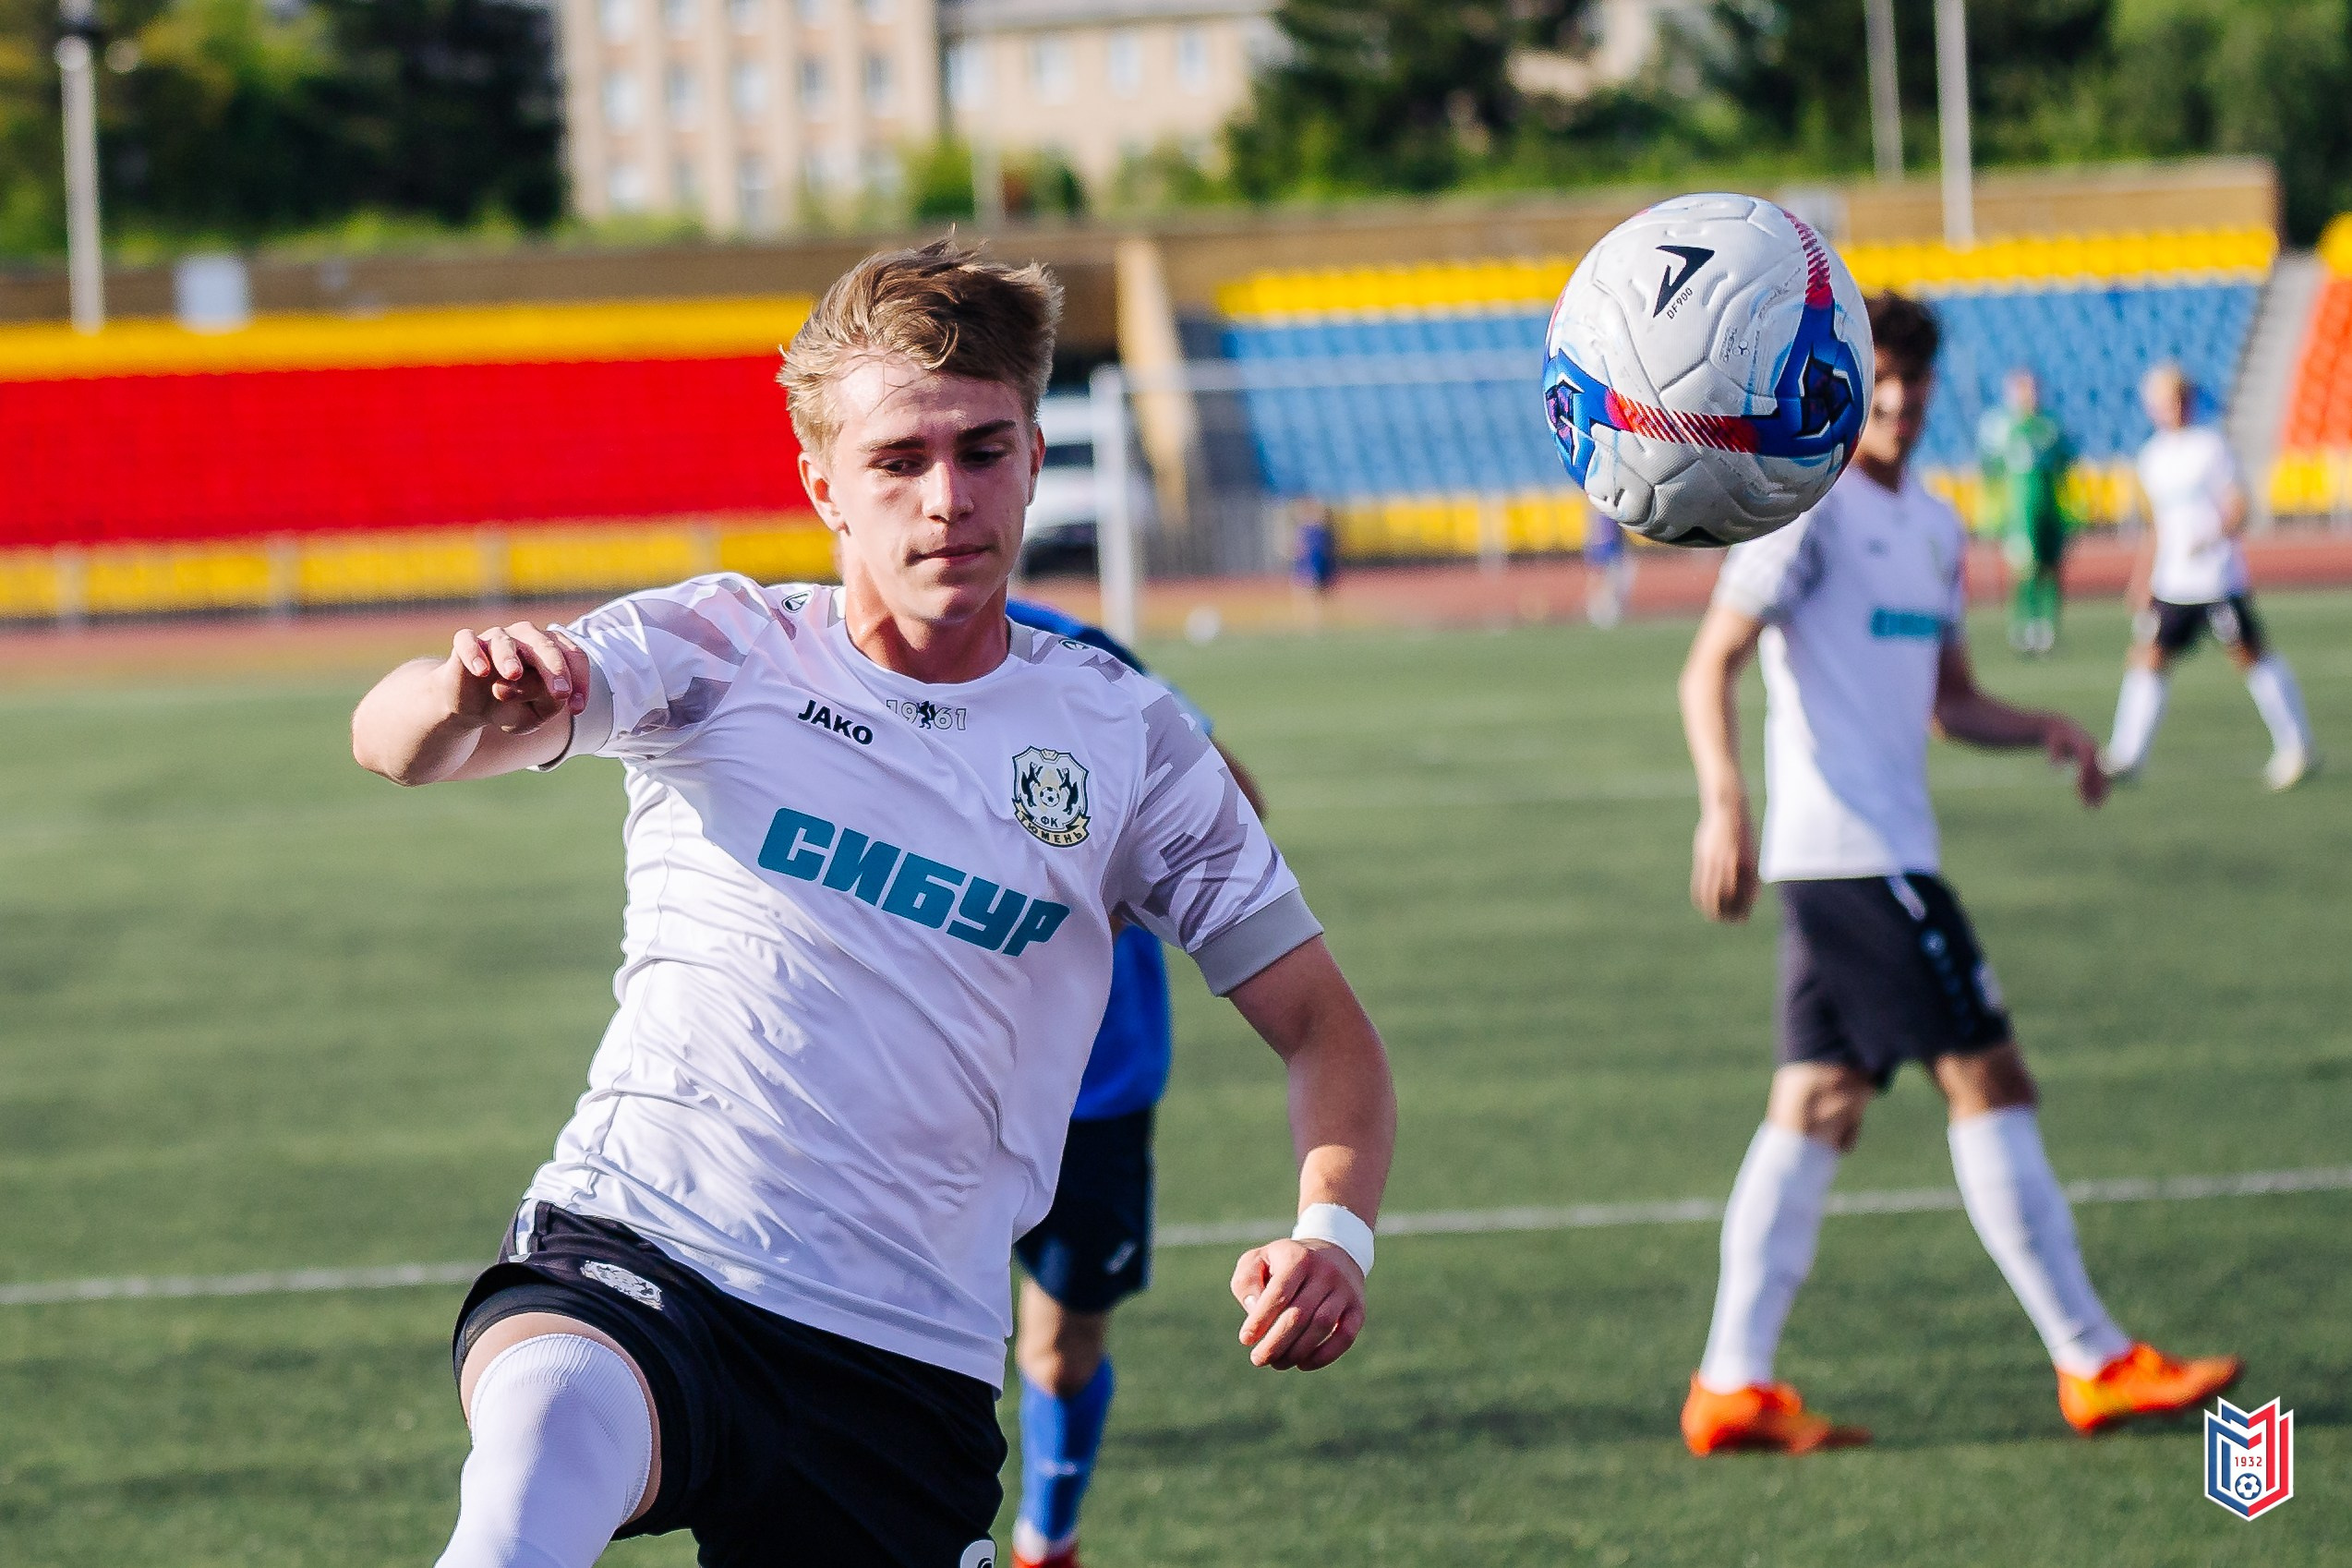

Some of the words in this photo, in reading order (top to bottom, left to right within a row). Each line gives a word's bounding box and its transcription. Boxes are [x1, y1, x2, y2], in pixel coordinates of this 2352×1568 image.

[1666, 287, 1694, 320] DF900
[798, 700, 874, 745] JAKO
[1021, 815, 1083, 843] ТЮМЕНЬ
[1041, 816, 1058, 827] ФК
[757, 807, 1070, 957] СИБУР
